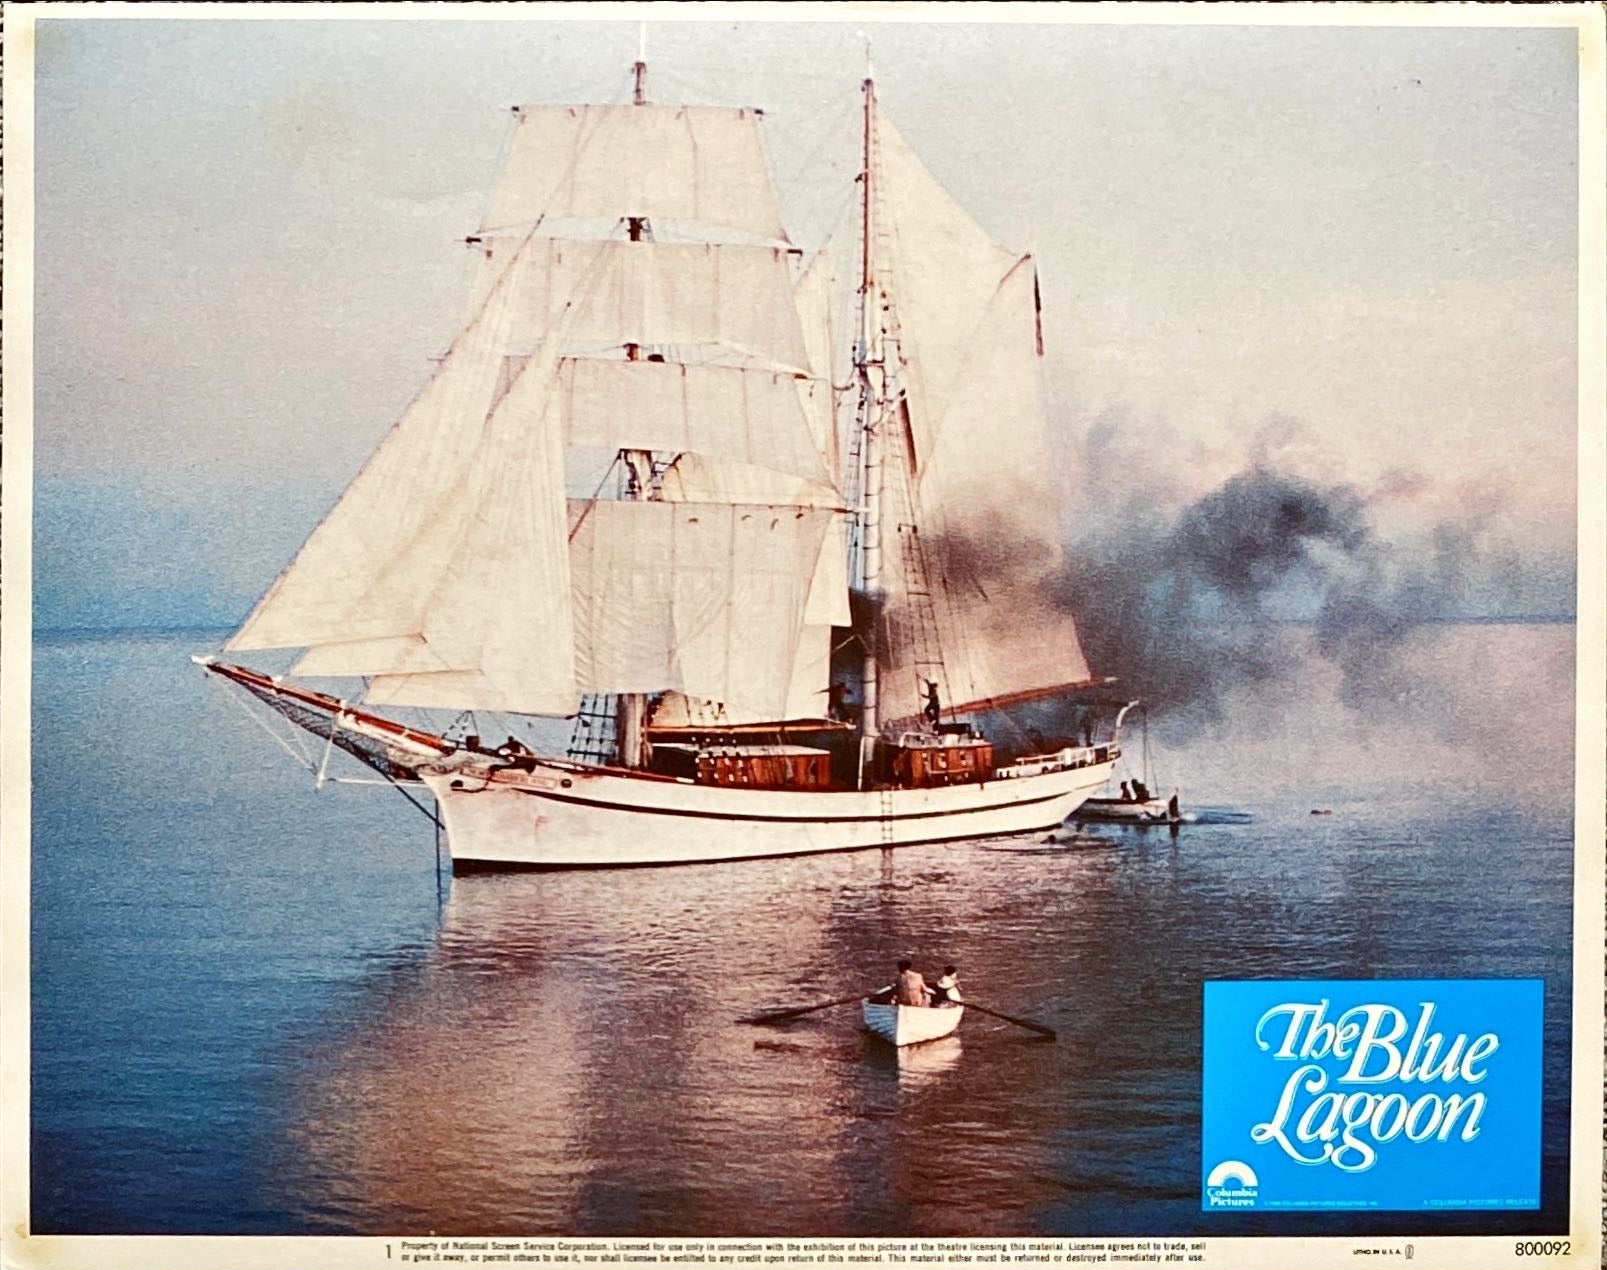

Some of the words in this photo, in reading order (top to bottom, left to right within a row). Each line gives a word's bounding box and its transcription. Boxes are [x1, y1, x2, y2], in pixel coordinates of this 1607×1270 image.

[1256, 998, 1360, 1060] The
[1337, 1001, 1499, 1084] Blue
[1250, 1065, 1487, 1172] Lagoon
[1207, 1188, 1258, 1197] Columbia
[1210, 1197, 1255, 1206] Pictures
[386, 1244, 391, 1259] 1
[401, 1242, 438, 1251] Property
[452, 1242, 488, 1250] National
[491, 1242, 520, 1250] Screen
[523, 1242, 555, 1250] Service
[557, 1242, 609, 1251] Corporation.
[613, 1242, 650, 1251] Licensed
[652, 1242, 664, 1250] for
[685, 1243, 703, 1252] only
[717, 1243, 762, 1251] connection
[765, 1243, 783, 1251] with
[786, 1243, 800, 1251] the
[803, 1243, 844, 1251] exhibition
[859, 1243, 874, 1251] this
[877, 1243, 906, 1251] picture
[921, 1243, 934, 1251] the
[937, 1243, 967, 1251] theatre
[970, 1243, 1006, 1251] licensing
[1010, 1242, 1025, 1250] this
[1028, 1242, 1066, 1250] material.
[1107, 1243, 1134, 1251] agrees
[1137, 1242, 1150, 1250] not
[1163, 1242, 1188, 1251] trade,
[1191, 1242, 1206, 1250] sell
[1515, 1241, 1570, 1256] 800092
[413, 1254, 431, 1262] give
[442, 1254, 467, 1262] away,
[482, 1253, 510, 1262] permit
[571, 1254, 580, 1263] it,
[600, 1254, 620, 1262] shall
[623, 1254, 657, 1262] licensee
[719, 1255, 734, 1263] any
[737, 1254, 761, 1262] credit
[764, 1255, 784, 1263] upon
[787, 1254, 813, 1262] return
[828, 1254, 843, 1262] this
[847, 1254, 885, 1262] material.
[888, 1253, 905, 1262] This
[910, 1254, 944, 1262] material
[948, 1254, 972, 1262] either
[976, 1254, 996, 1262] must
[1014, 1253, 1049, 1262] returned
[1066, 1253, 1106, 1263] destroyed
[1110, 1253, 1161, 1262] immediately
[1165, 1253, 1183, 1261] after
